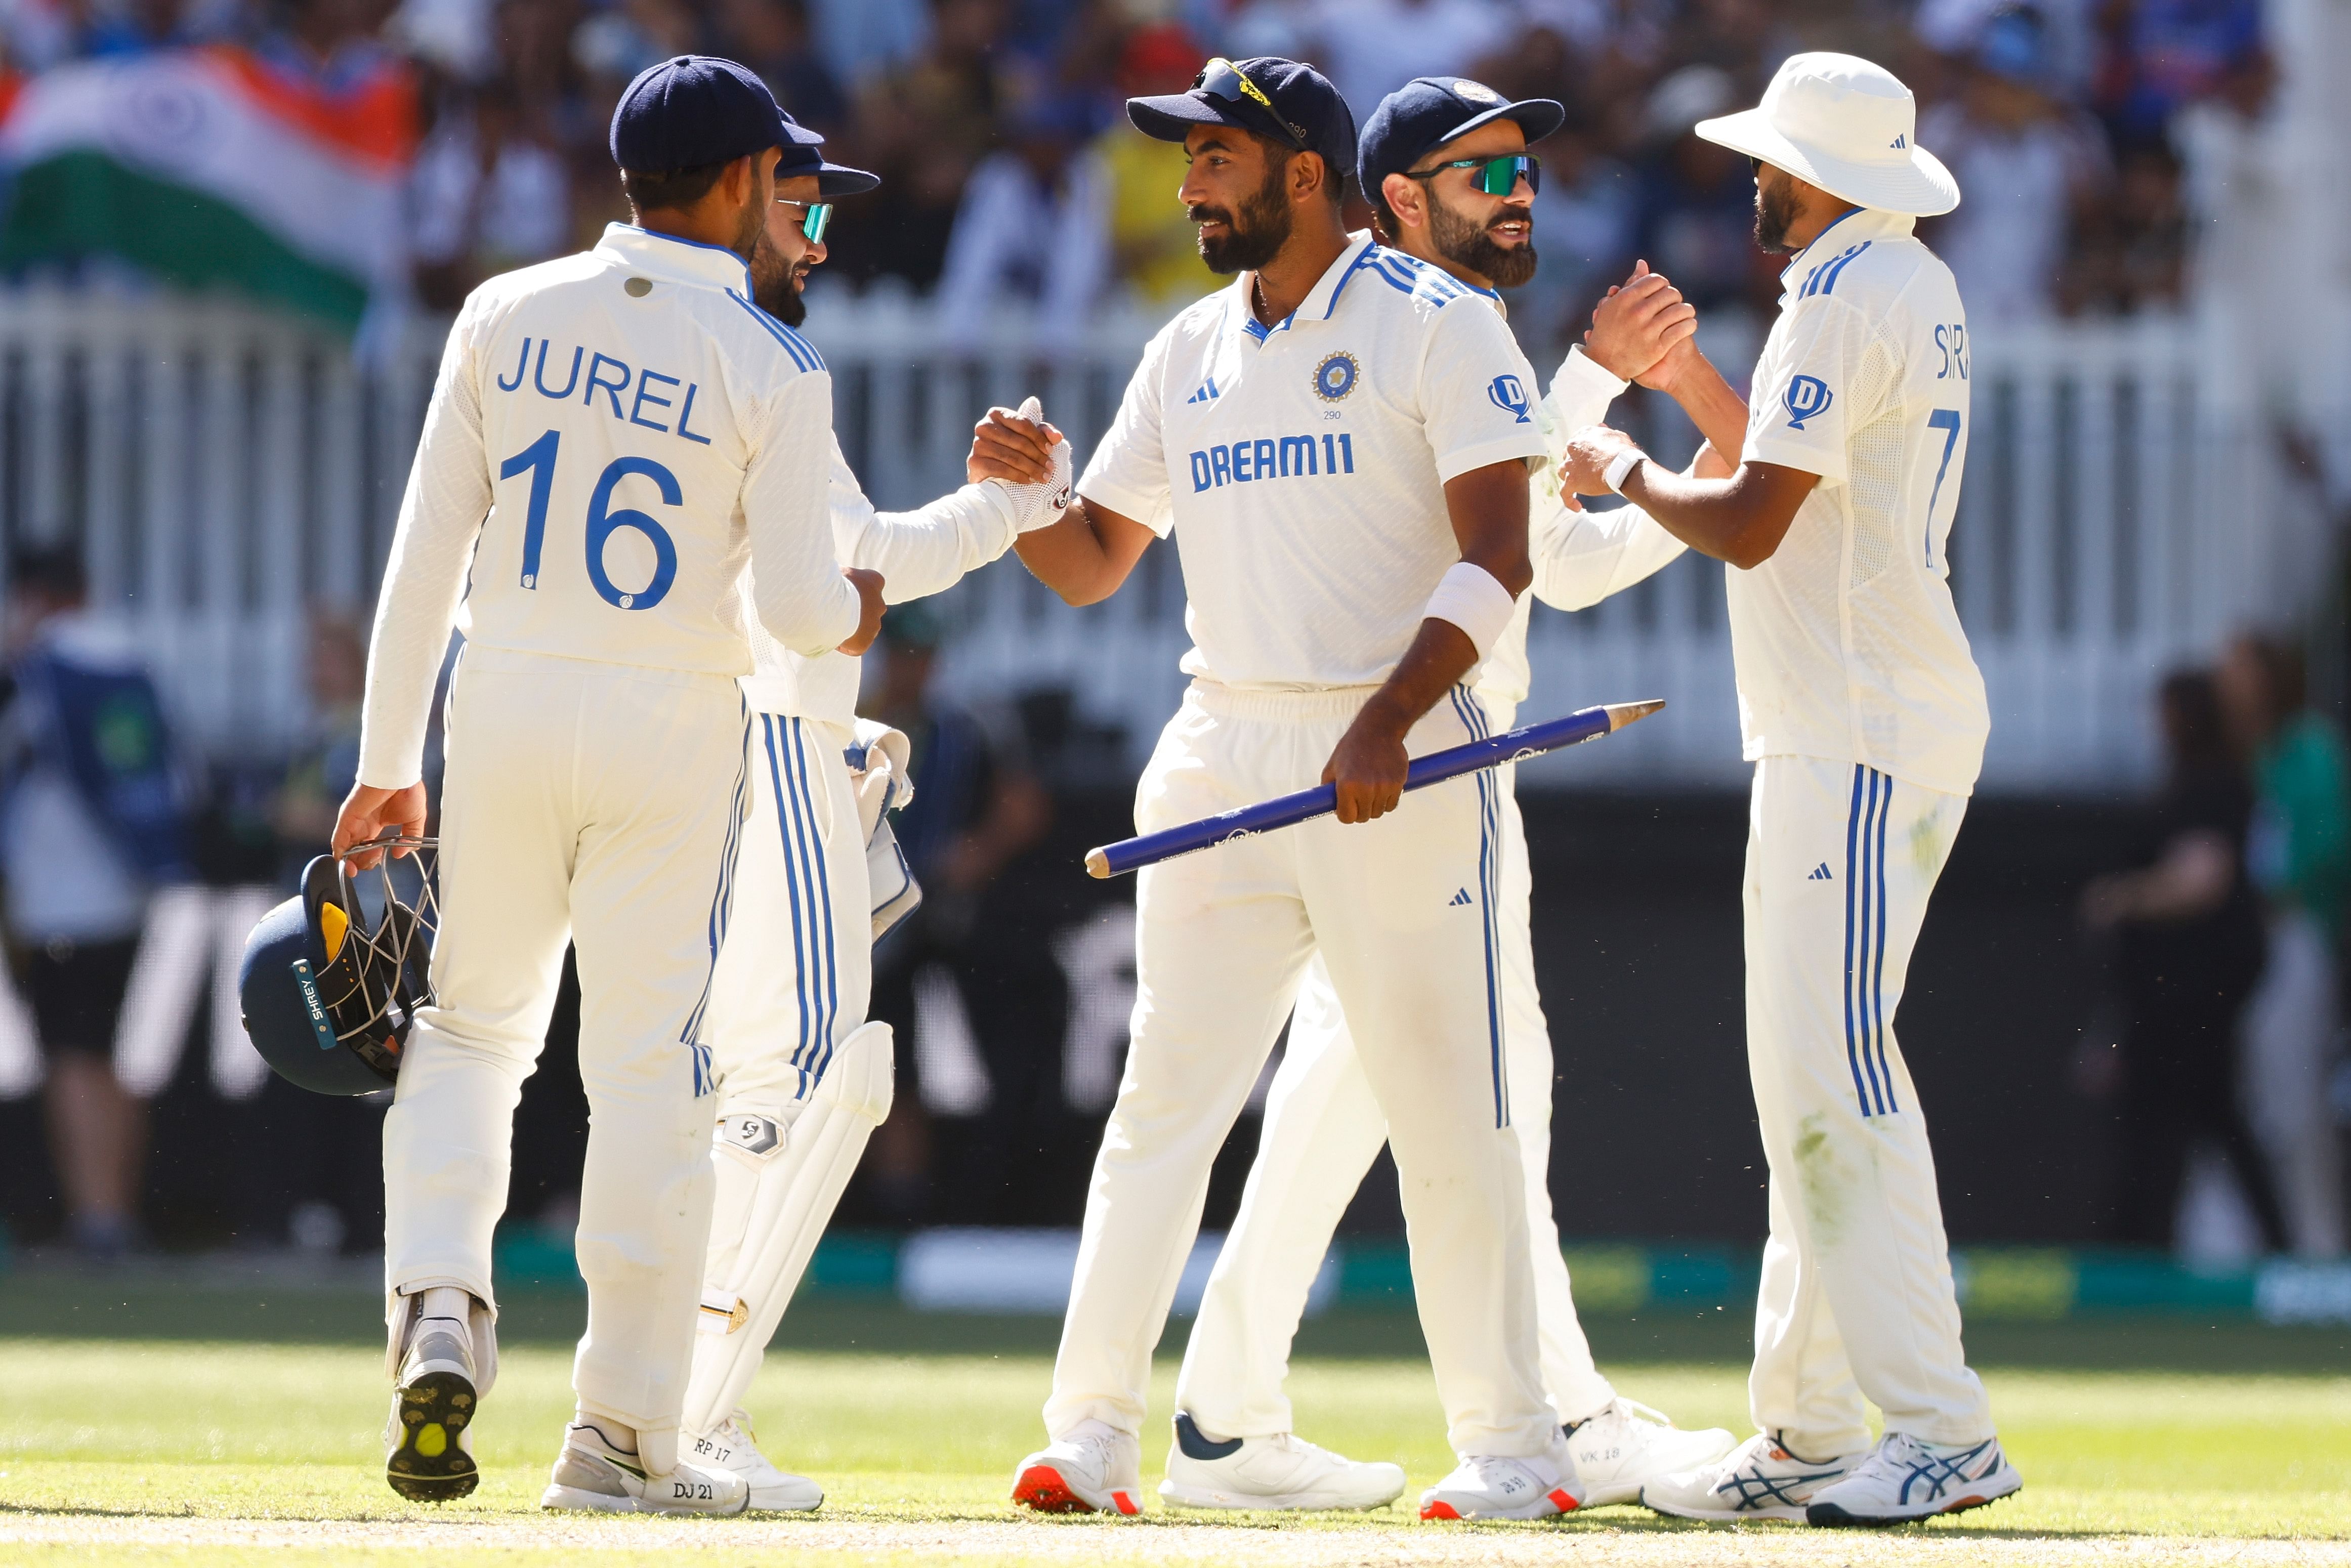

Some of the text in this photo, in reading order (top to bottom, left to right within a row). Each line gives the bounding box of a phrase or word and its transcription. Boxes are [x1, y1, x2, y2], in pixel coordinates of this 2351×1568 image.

[497, 337, 711, 446] JUREL
[1323, 410, 1341, 419] 290
[1189, 433, 1354, 493] DREAM11
[500, 429, 683, 611] 16
[302, 980, 323, 1020] SHREY
[694, 1438, 731, 1462] RP 17
[673, 1482, 713, 1500] DJ 21
